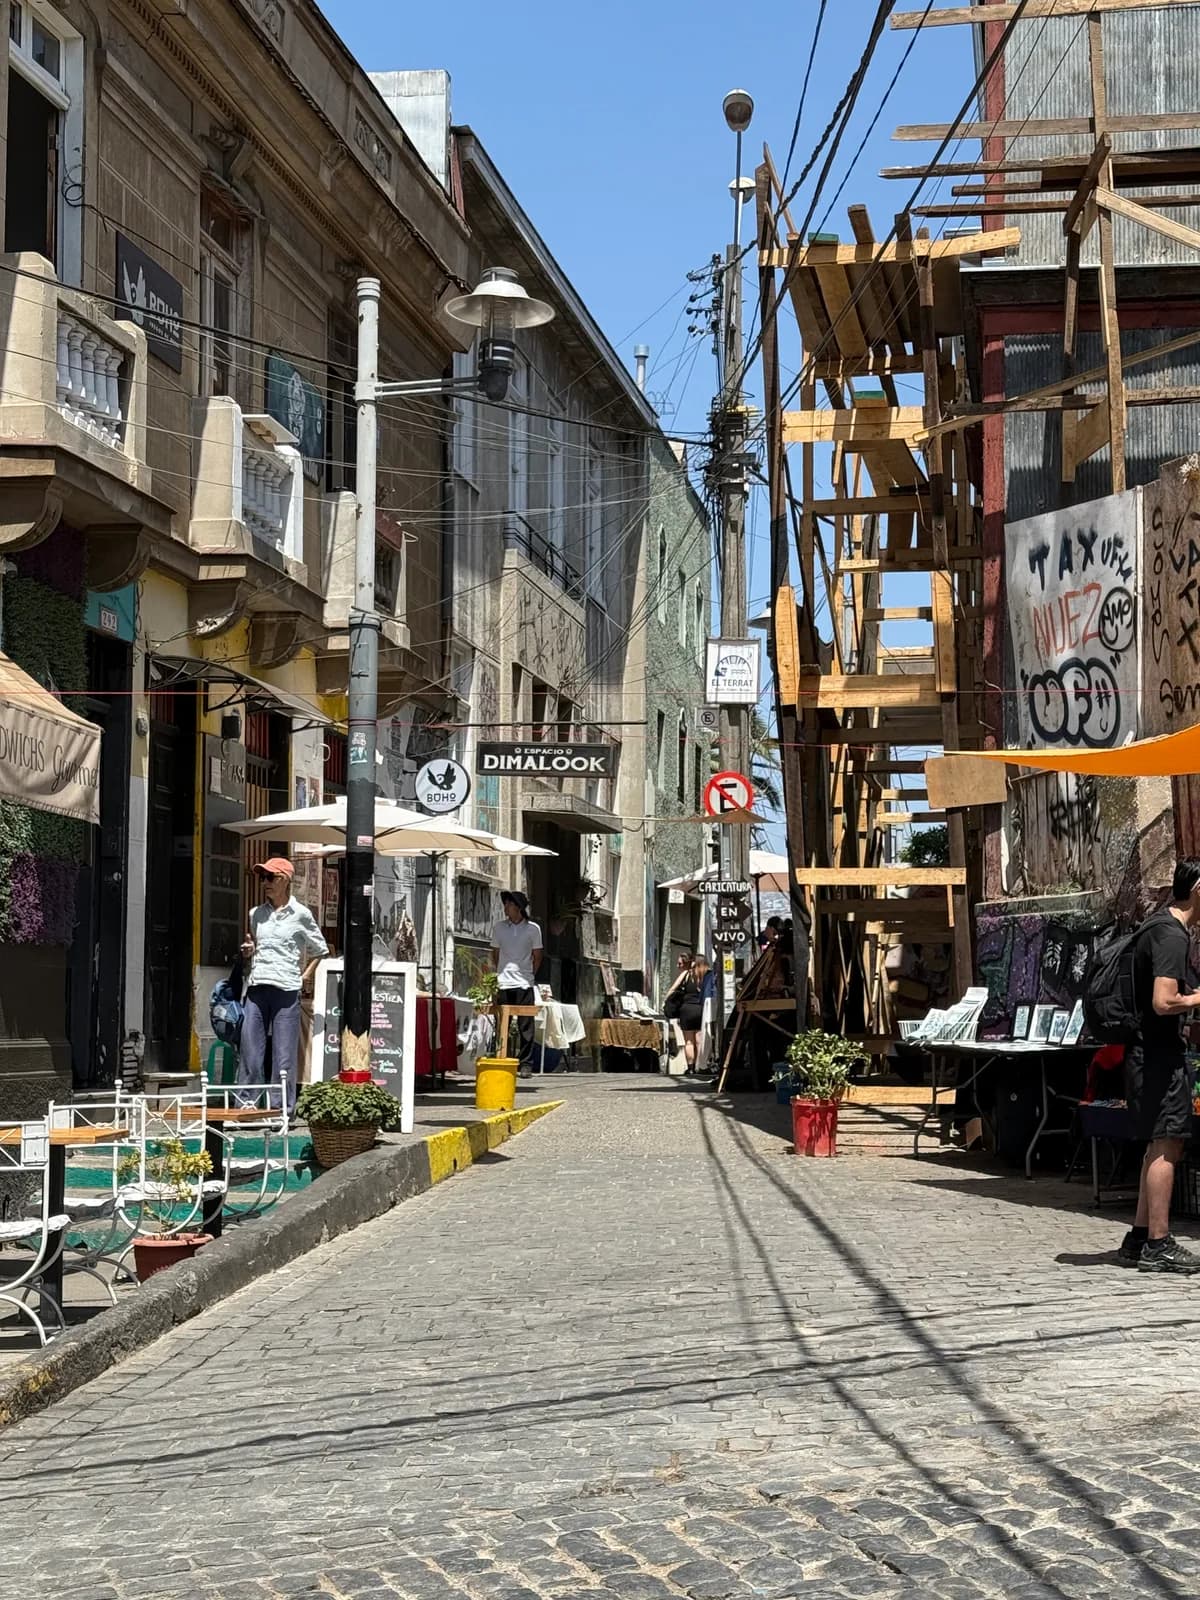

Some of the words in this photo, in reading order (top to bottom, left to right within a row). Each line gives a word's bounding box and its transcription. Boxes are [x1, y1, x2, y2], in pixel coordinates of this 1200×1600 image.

[483, 754, 606, 772] DIMALOOK
[720, 907, 738, 917] EN
[714, 931, 746, 942] VIVO
